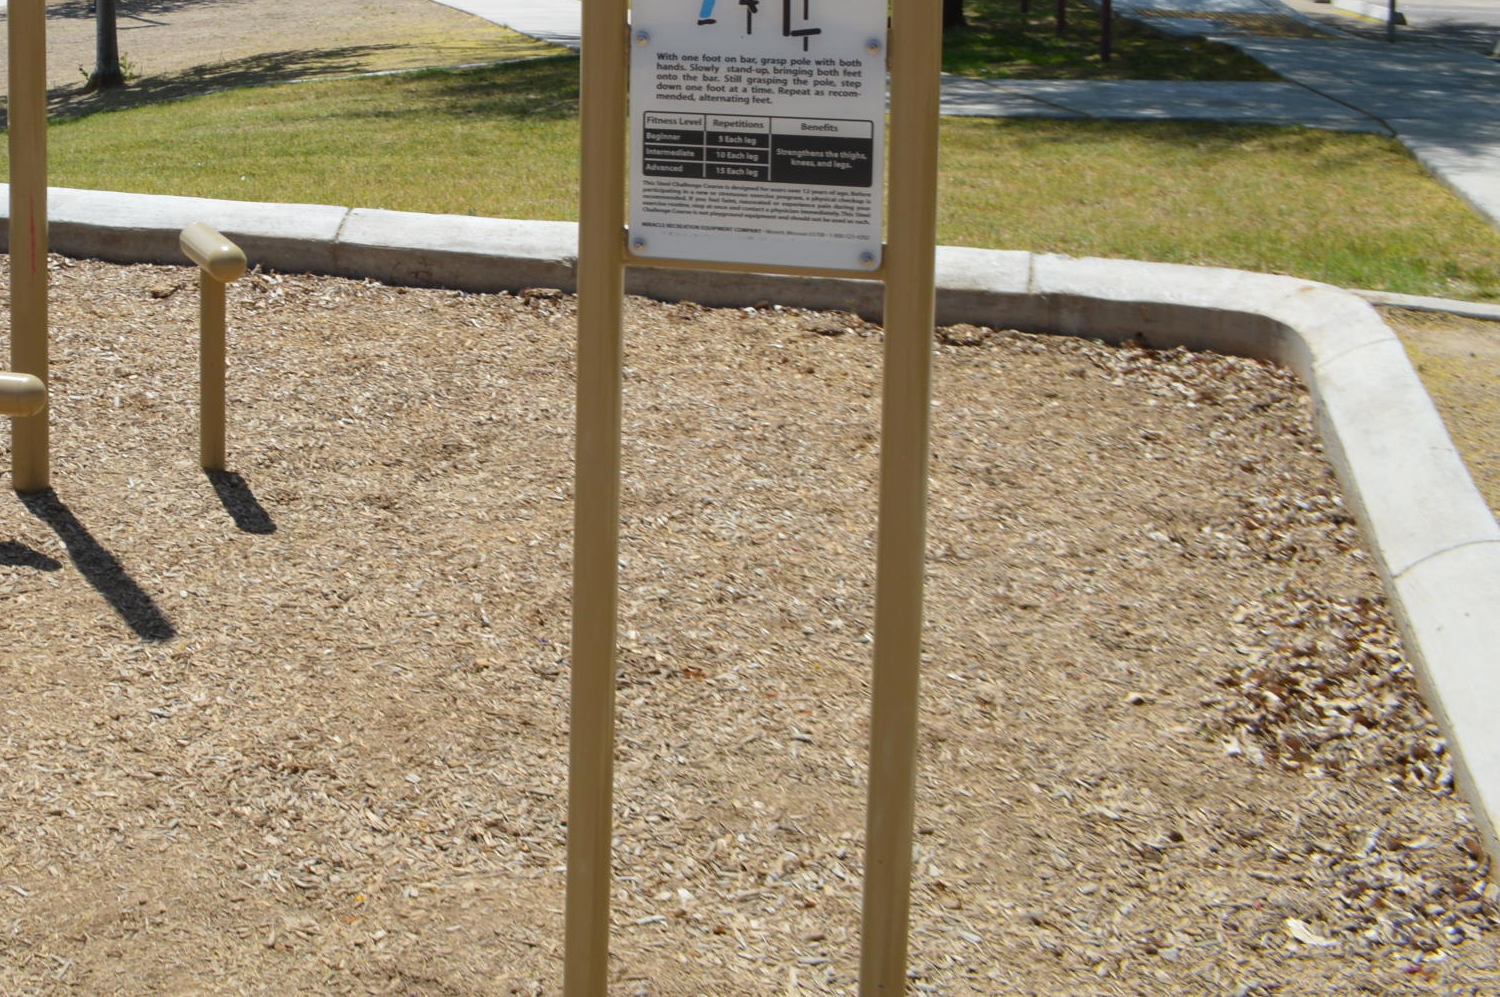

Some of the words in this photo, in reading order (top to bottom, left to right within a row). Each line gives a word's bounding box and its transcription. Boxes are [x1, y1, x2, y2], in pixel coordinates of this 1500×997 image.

[657, 52, 678, 61] With
[702, 54, 721, 62] foot
[740, 55, 758, 64] bar,
[761, 58, 787, 66] grasp
[790, 57, 811, 66] pole
[815, 58, 835, 66] with
[839, 59, 862, 67] both
[657, 62, 686, 71] hands.
[690, 64, 719, 73] Slowly
[773, 67, 813, 77] bringing
[817, 68, 839, 76] both
[843, 69, 862, 77] feet
[682, 73, 698, 81] the
[702, 74, 720, 82] bar.
[724, 75, 742, 83] Still
[746, 77, 788, 86] grasping
[792, 77, 808, 85] the
[841, 80, 862, 88] step
[706, 84, 725, 92] foot
[751, 86, 774, 94] time.
[778, 87, 810, 96] Repeat
[699, 94, 750, 104] alternating
[752, 96, 773, 104] feet.
[646, 116, 677, 125] Fitness
[679, 118, 702, 126] Level
[713, 119, 764, 129] Repetitions
[801, 123, 838, 132] Benefits
[646, 132, 681, 141] Beginner
[744, 137, 757, 146] leg
[645, 148, 695, 157] Intermediate
[727, 151, 745, 159] Each
[746, 152, 759, 162] leg
[825, 150, 839, 158] the
[645, 164, 683, 172] Advanced
[727, 167, 744, 175] Each
[746, 168, 758, 177] leg
